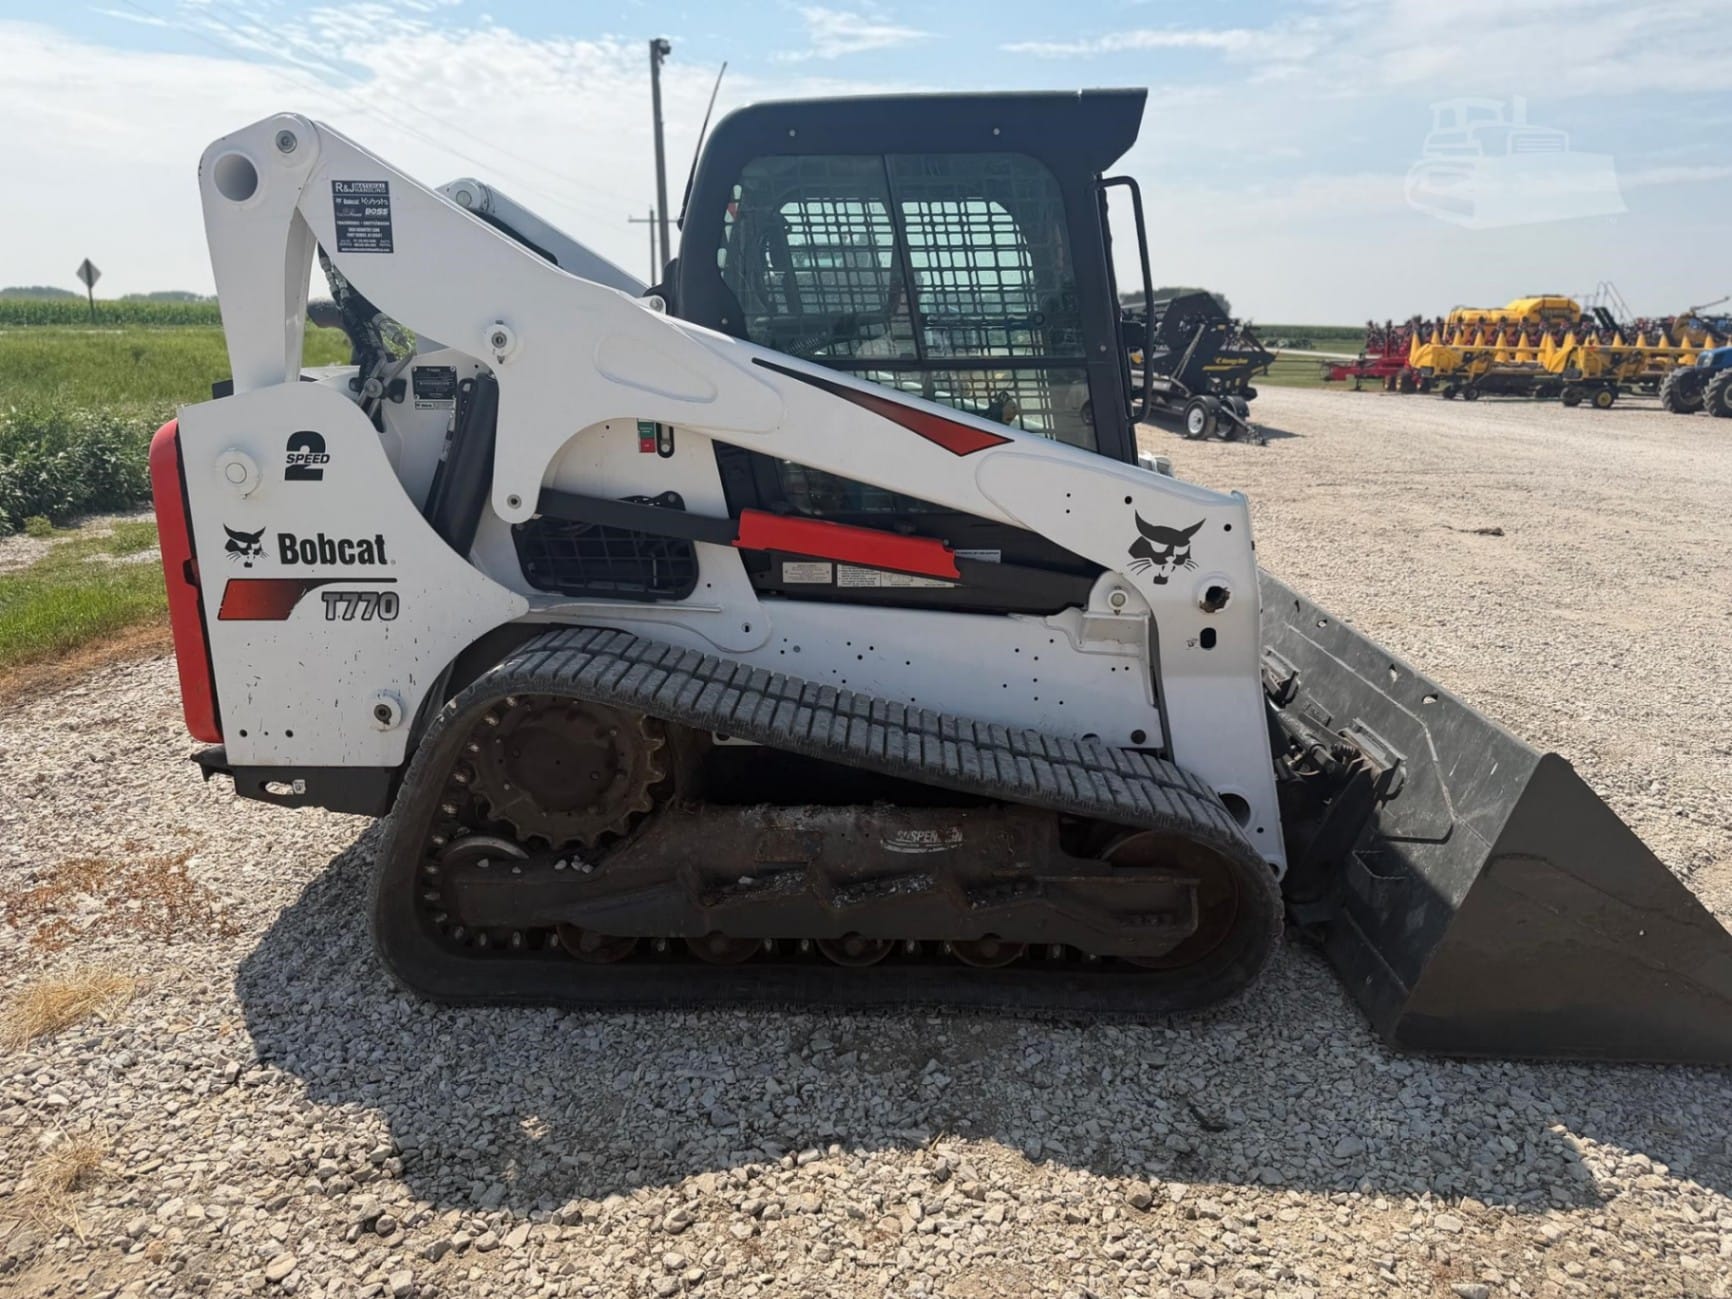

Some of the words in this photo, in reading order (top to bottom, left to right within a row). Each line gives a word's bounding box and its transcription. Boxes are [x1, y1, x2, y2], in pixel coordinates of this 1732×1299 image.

[335, 182, 354, 193] R&J
[365, 207, 388, 215] BOSS
[284, 430, 326, 481] 2
[286, 453, 330, 464] SPEED
[277, 532, 388, 565] Bobcat
[321, 591, 400, 621] T770
